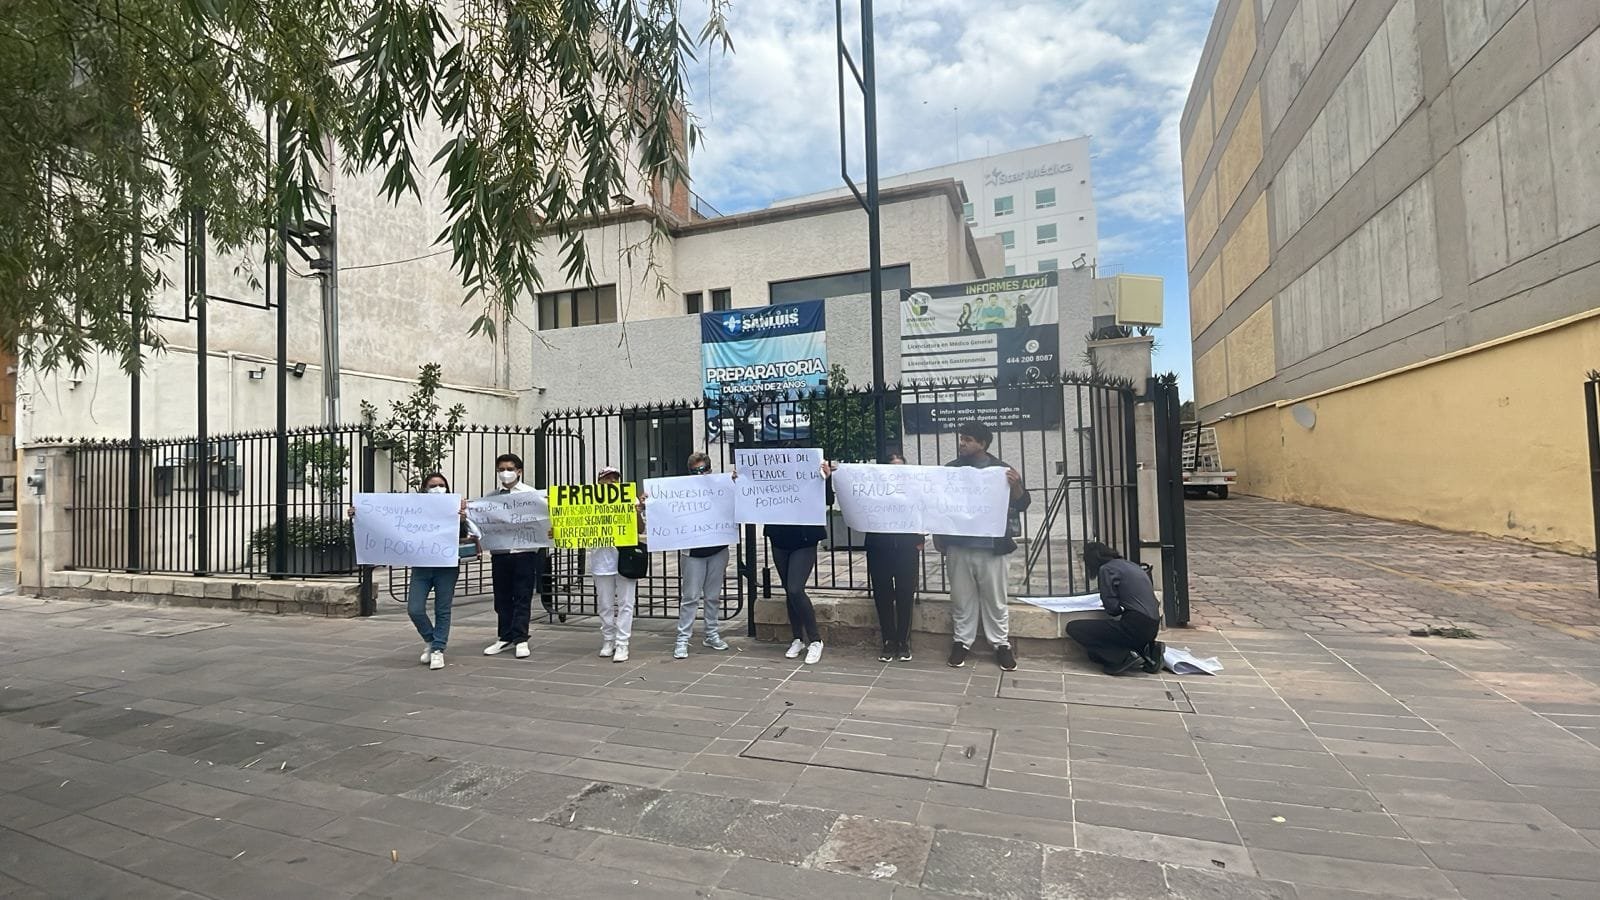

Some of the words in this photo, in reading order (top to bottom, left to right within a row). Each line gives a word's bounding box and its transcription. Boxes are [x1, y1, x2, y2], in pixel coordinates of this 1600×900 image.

[966, 281, 1019, 295] INFORMES
[706, 359, 826, 382] PREPARATORIA
[764, 382, 776, 392] DE
[777, 381, 784, 390] 2
[763, 453, 793, 467] PARTE
[795, 453, 810, 463] DEL
[751, 469, 790, 480] FRAUDE
[796, 471, 808, 480] DE
[557, 483, 632, 506] FRAUDE
[741, 483, 800, 497] UNIVERSIDAD
[852, 482, 907, 498] FRAUDE
[594, 504, 626, 514] POTOSINA
[627, 503, 635, 513] DE
[754, 495, 802, 508] POTOSINA
[601, 525, 614, 537] NO
[617, 524, 626, 536] TE
[652, 526, 671, 537] NO
[675, 525, 689, 535] TE
[384, 537, 456, 558] ROBADO
